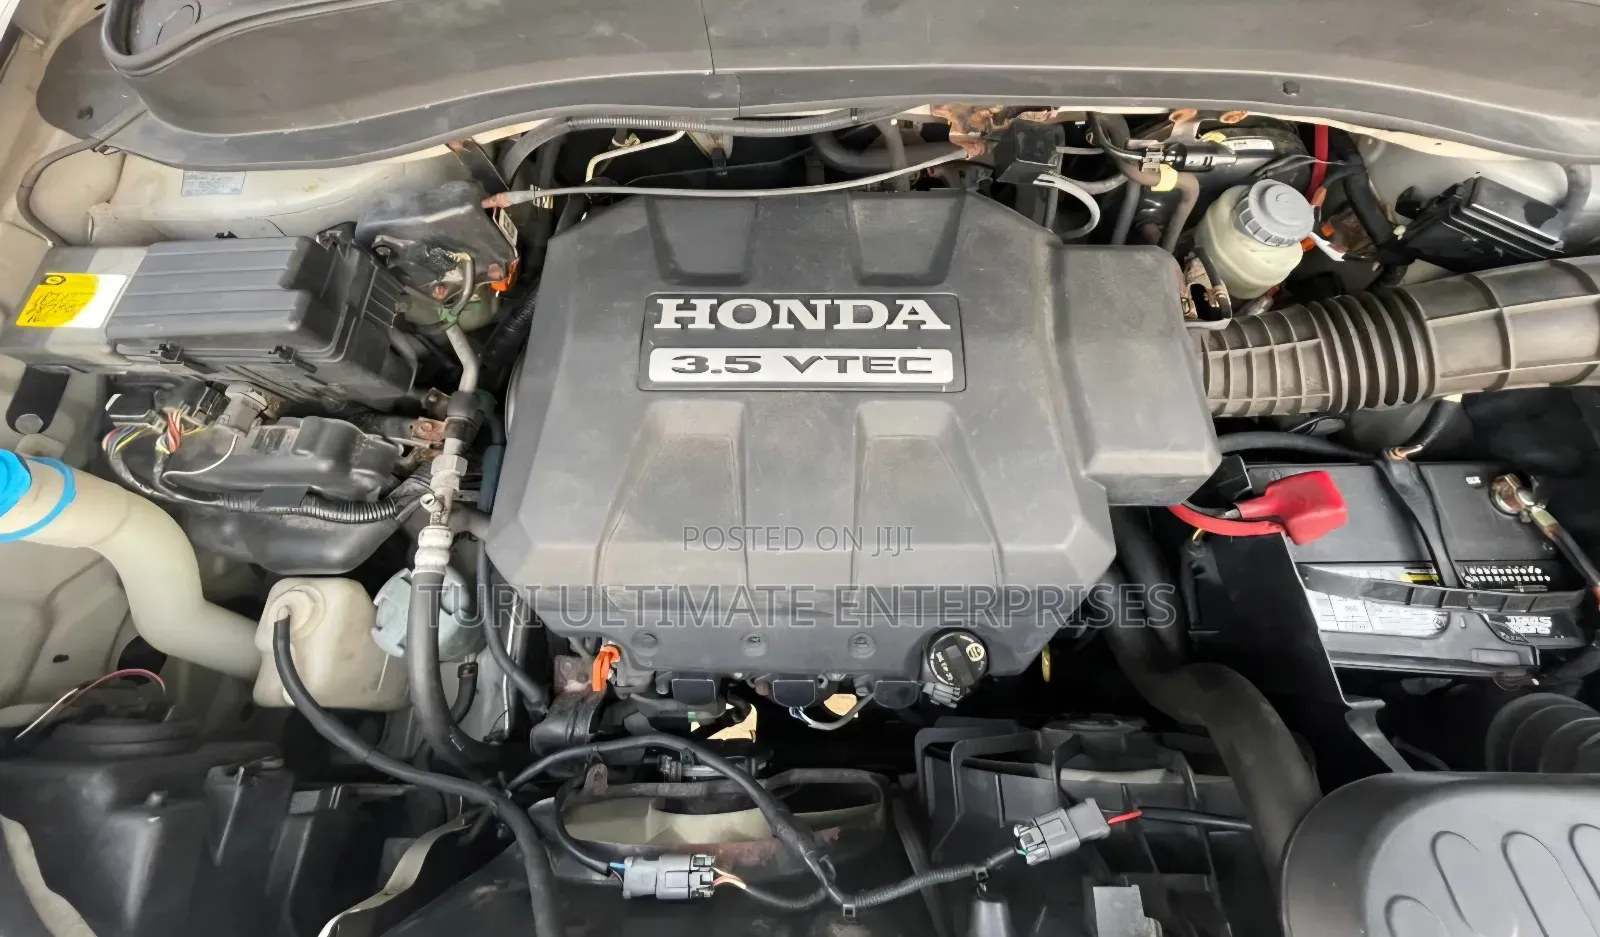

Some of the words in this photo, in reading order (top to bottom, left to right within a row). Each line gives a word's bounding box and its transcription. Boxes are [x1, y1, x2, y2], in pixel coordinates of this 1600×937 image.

[654, 298, 951, 330] HONDA
[671, 355, 762, 374] 3.5
[783, 355, 933, 374] VTEC
